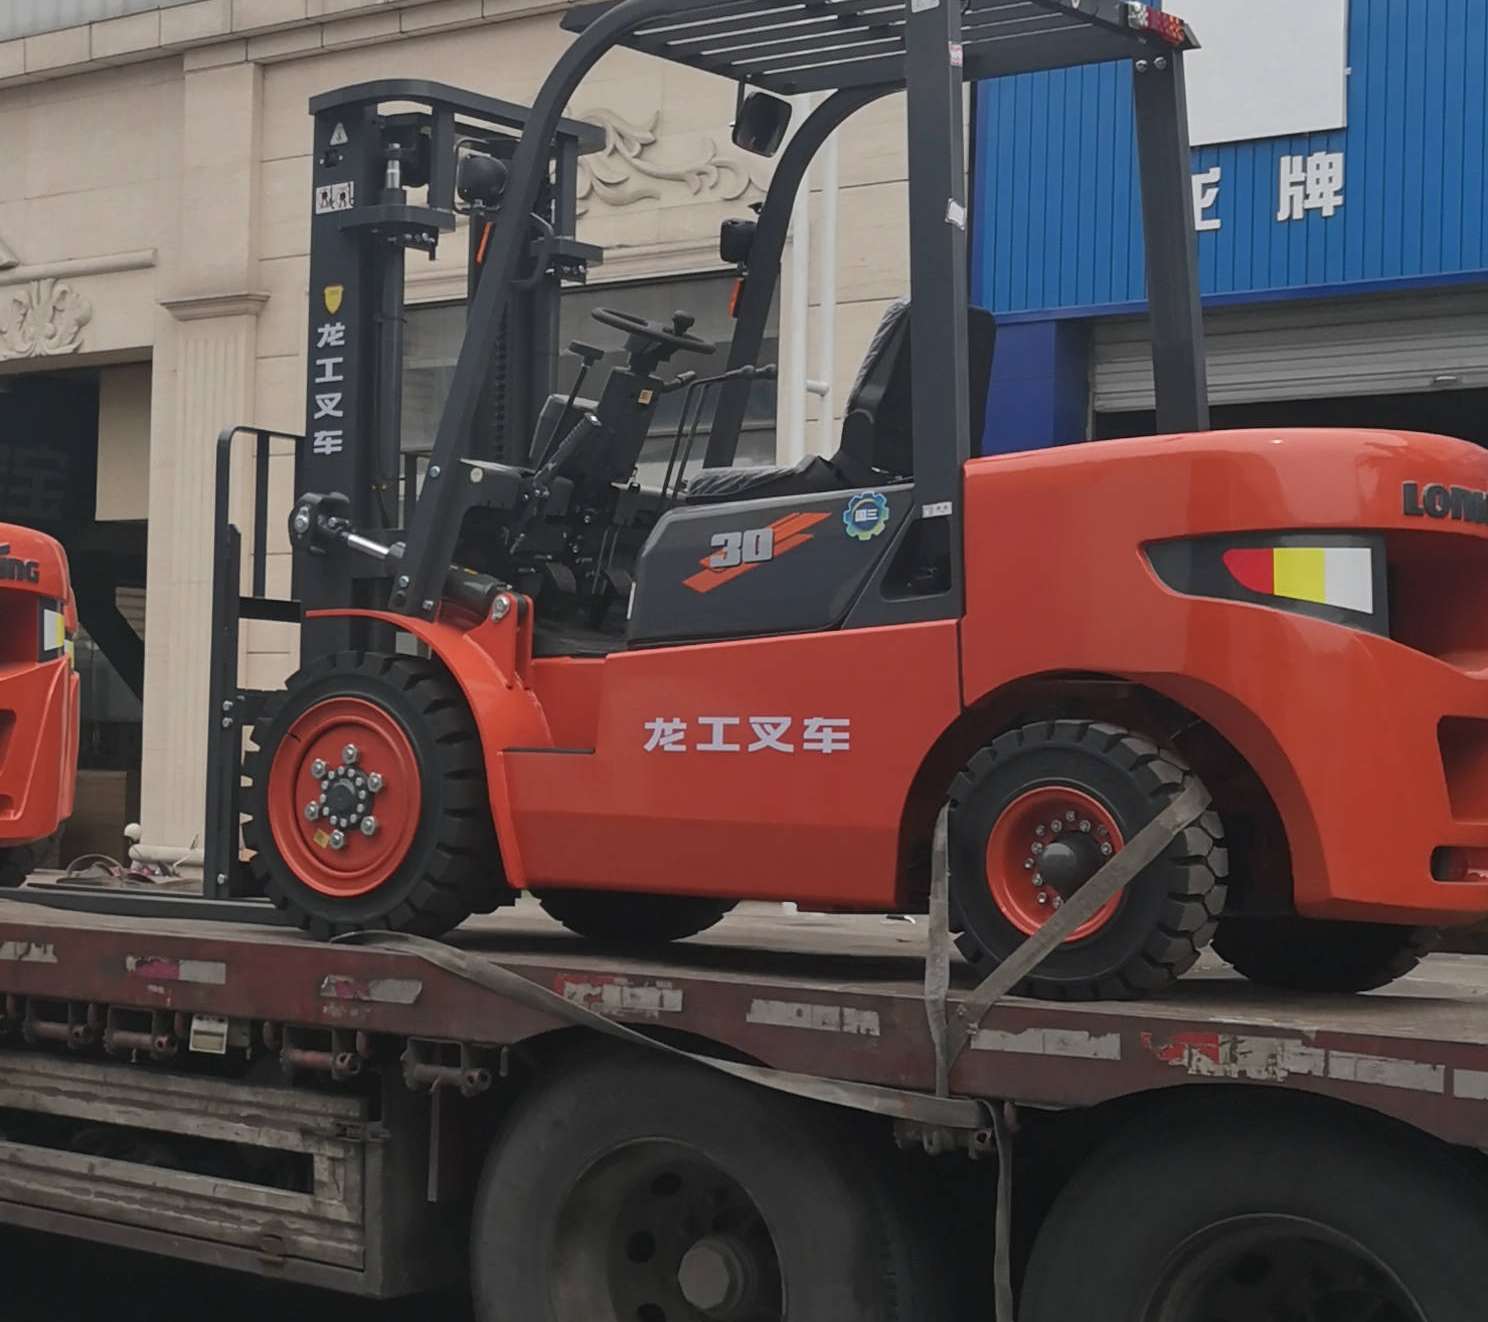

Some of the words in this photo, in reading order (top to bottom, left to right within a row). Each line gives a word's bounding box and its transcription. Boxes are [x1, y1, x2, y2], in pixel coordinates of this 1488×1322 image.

[313, 321, 346, 455] 龙工叉车
[710, 527, 774, 569] 30
[643, 716, 851, 754] 龙工叉车
